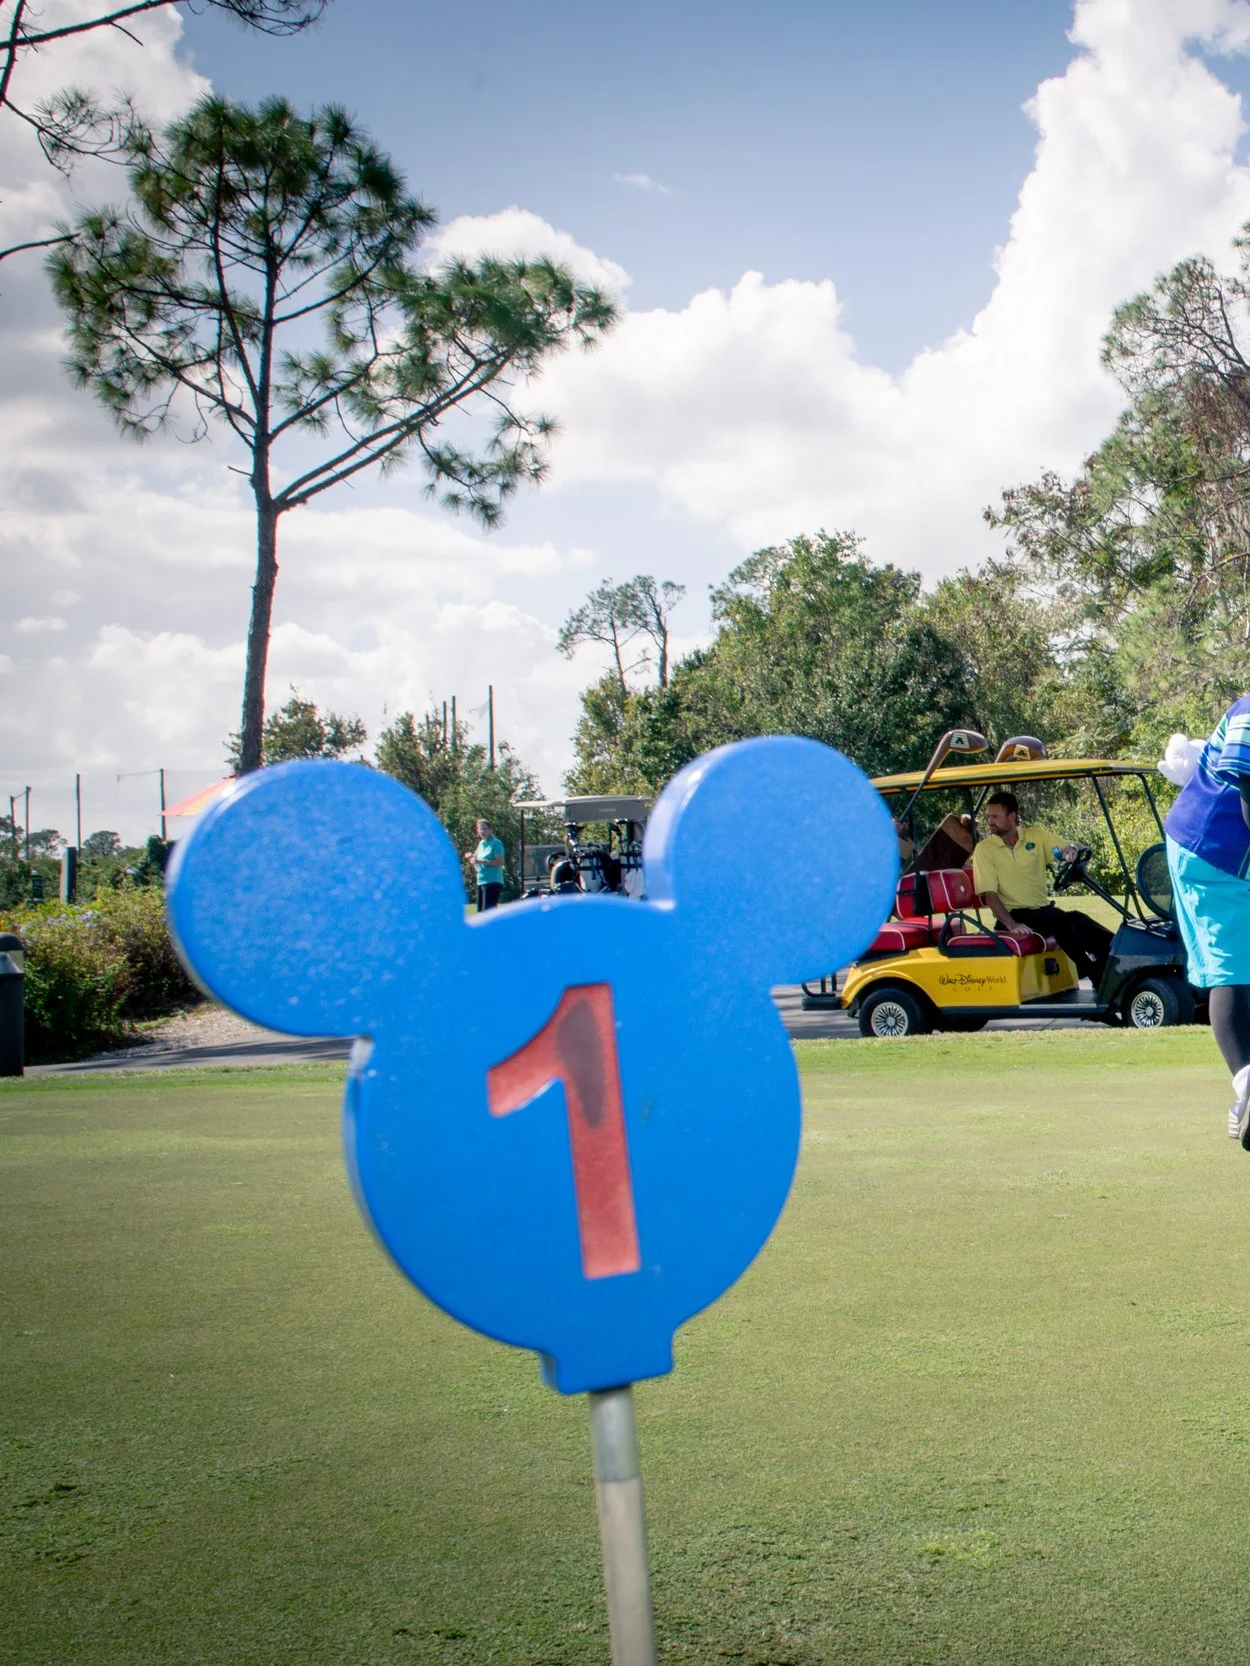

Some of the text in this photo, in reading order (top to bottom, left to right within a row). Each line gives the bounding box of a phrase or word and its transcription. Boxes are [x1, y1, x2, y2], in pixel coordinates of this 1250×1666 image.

[955, 974, 986, 988] Disney
[986, 976, 1008, 984] World
[486, 980, 641, 1280] 1
